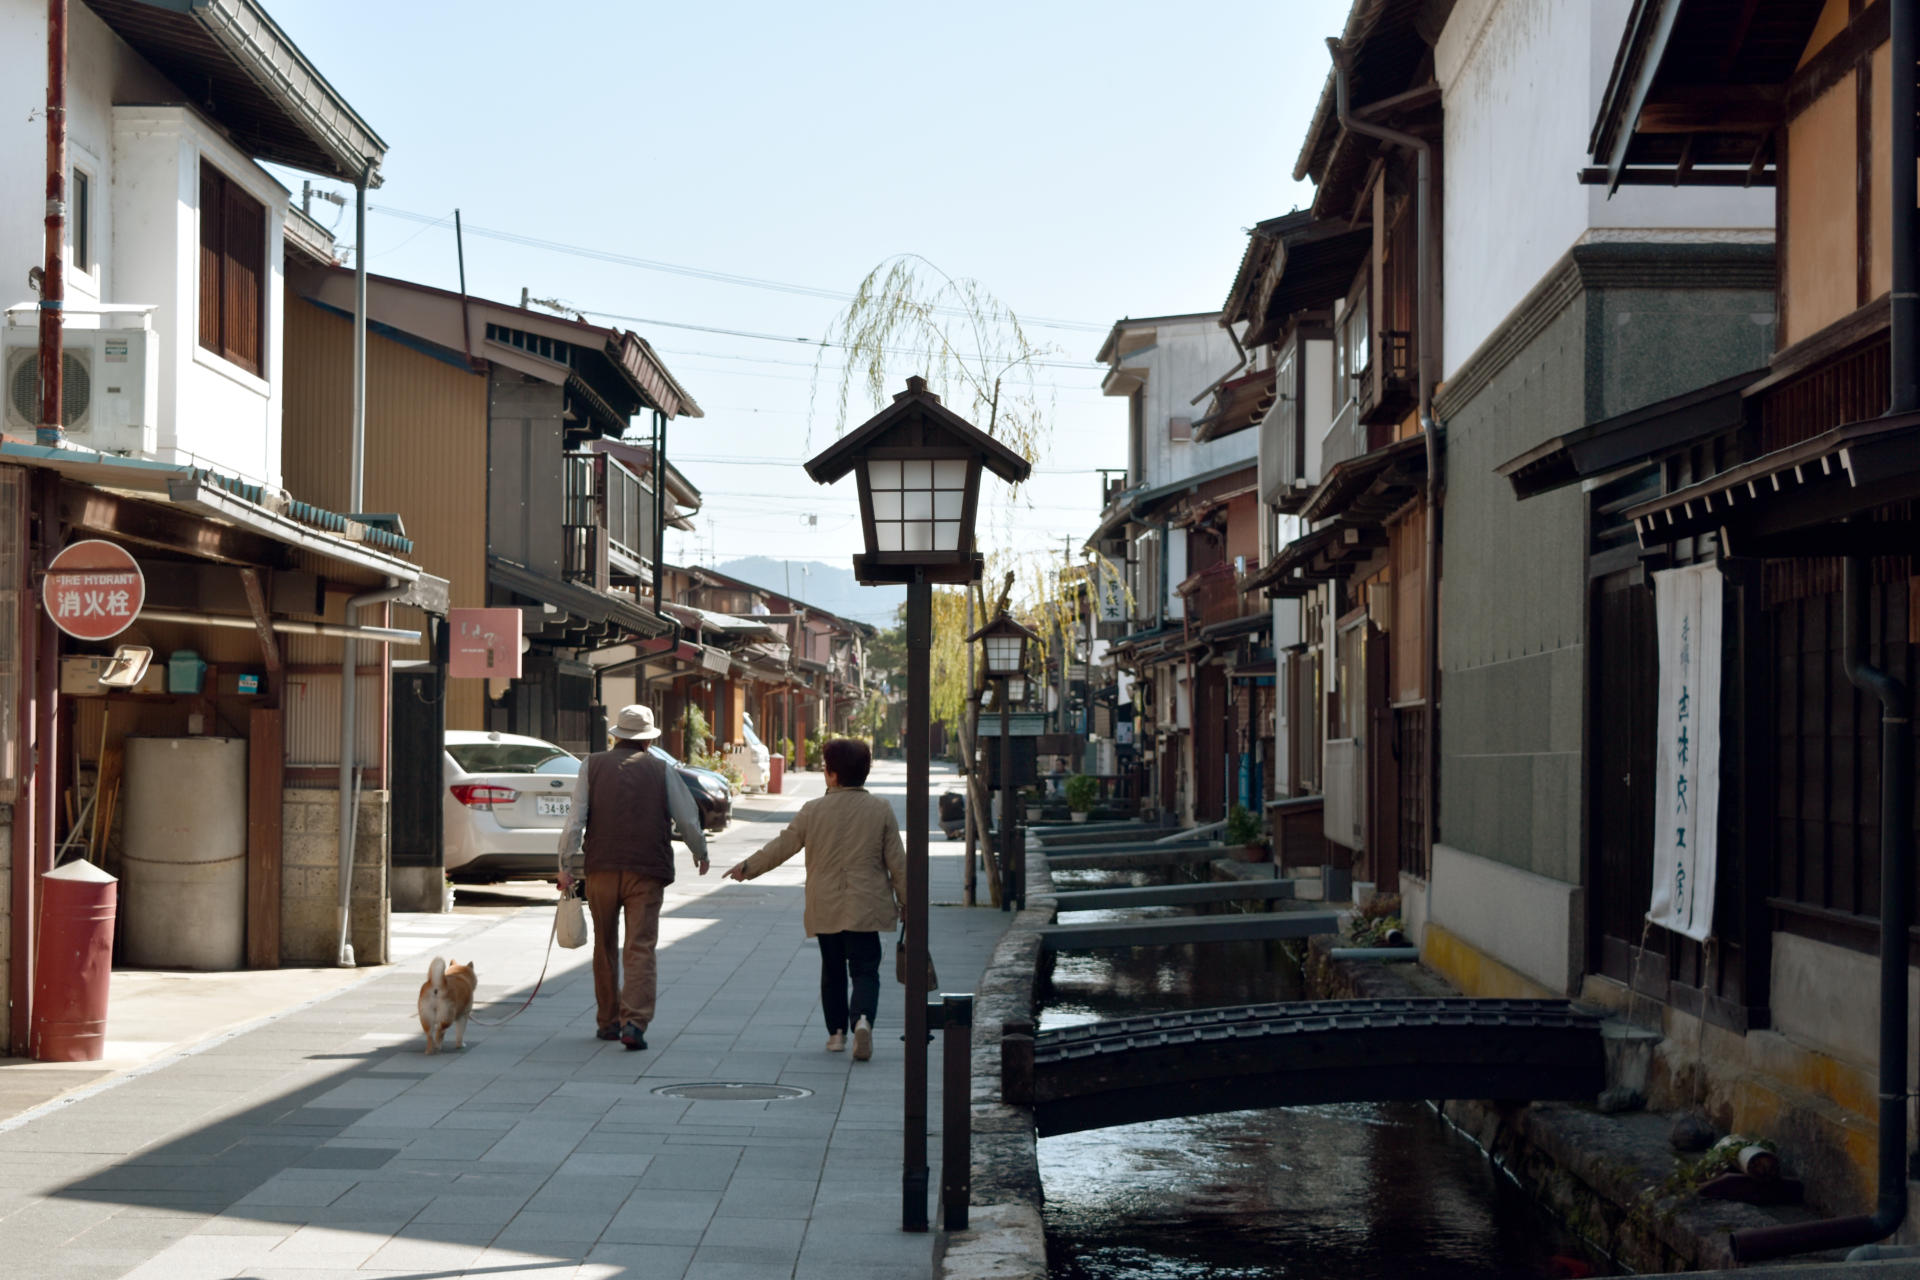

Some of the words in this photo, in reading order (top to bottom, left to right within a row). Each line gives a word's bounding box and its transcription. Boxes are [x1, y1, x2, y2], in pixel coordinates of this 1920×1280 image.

[84, 574, 136, 585] HYDRANT
[57, 590, 130, 617] 消火栓
